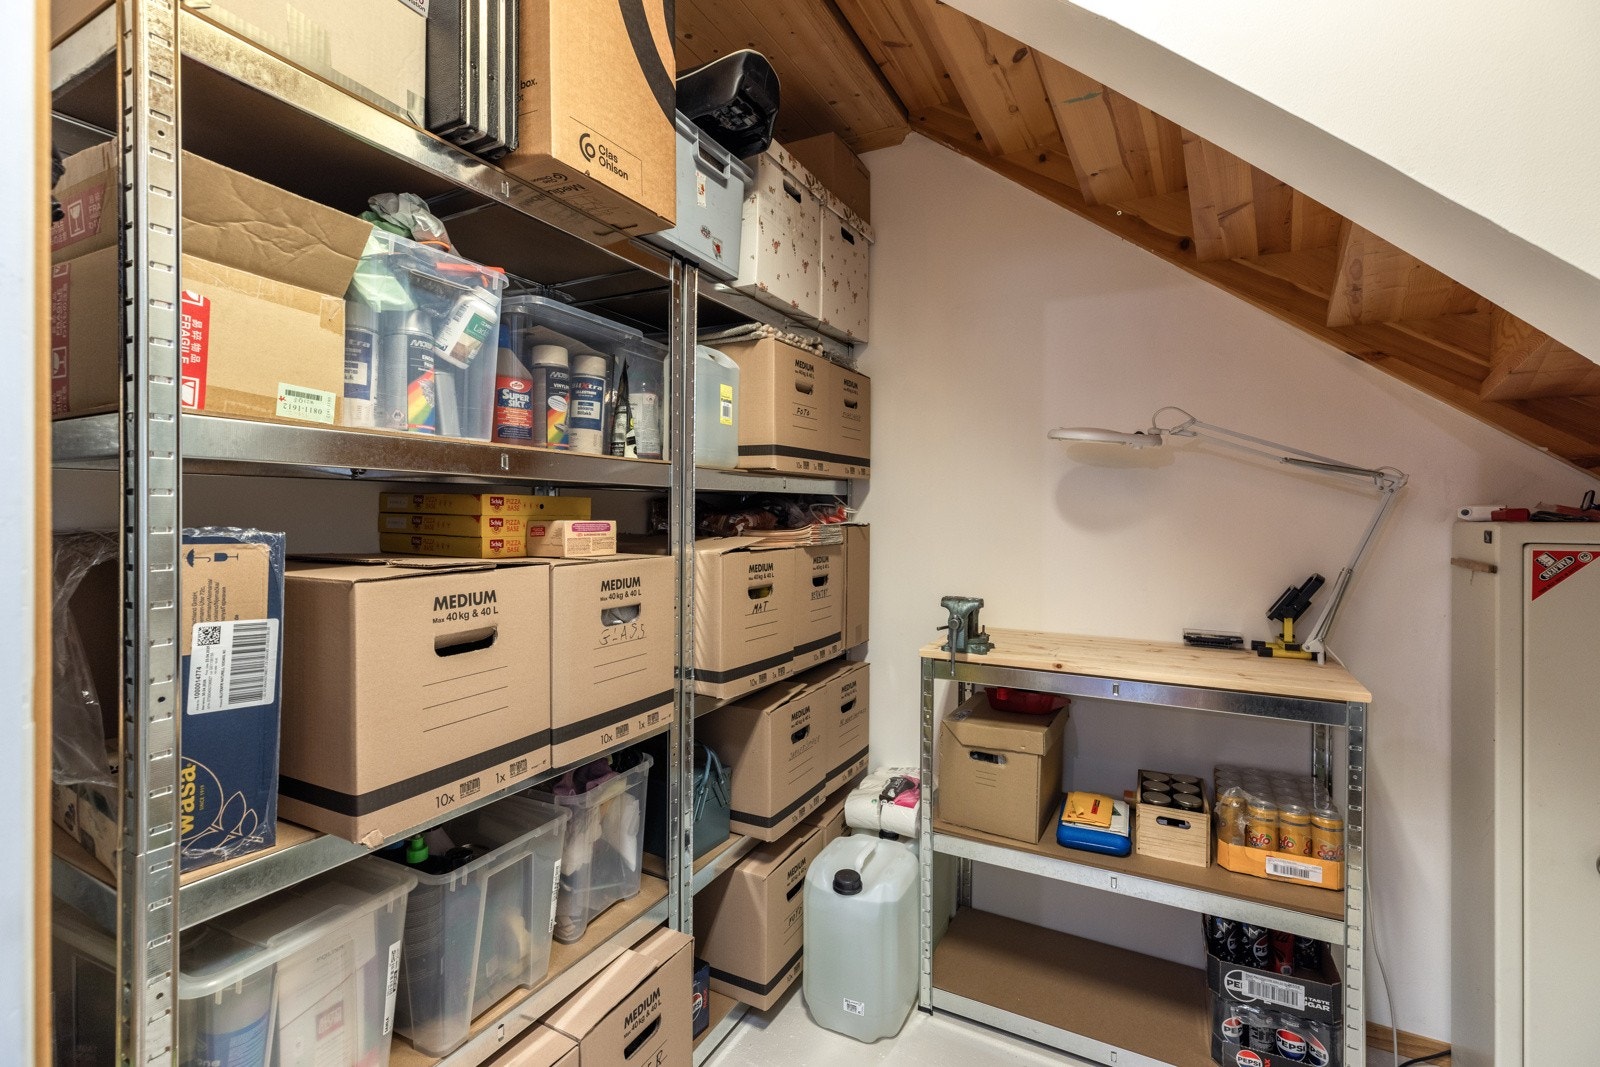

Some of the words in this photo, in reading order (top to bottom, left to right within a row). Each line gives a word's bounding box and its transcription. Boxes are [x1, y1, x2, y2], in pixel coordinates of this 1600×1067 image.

[598, 144, 619, 164] Clas
[598, 156, 629, 180] Ohlson
[795, 359, 814, 373] MEDIUM
[502, 388, 530, 403] SUPER
[508, 400, 526, 409] SIKT
[812, 556, 829, 564] MEDIUM
[748, 562, 774, 574] MEDIUM
[600, 576, 641, 592] MEDIUM
[433, 590, 497, 611] MEDIUM
[472, 609, 480, 618] &
[481, 607, 492, 617] 40
[493, 606, 499, 615] L
[791, 706, 811, 721] MEDIUM
[600, 733, 614, 745] 10x
[436, 794, 455, 809] 10x
[496, 772, 506, 785] 1x
[787, 857, 807, 880] MEDIUM
[624, 987, 661, 1029] MEDIUM
[1309, 998, 1330, 1006] TASTE
[1277, 1036, 1306, 1053] PEPSI
[1238, 1057, 1261, 1067] PEPSI
